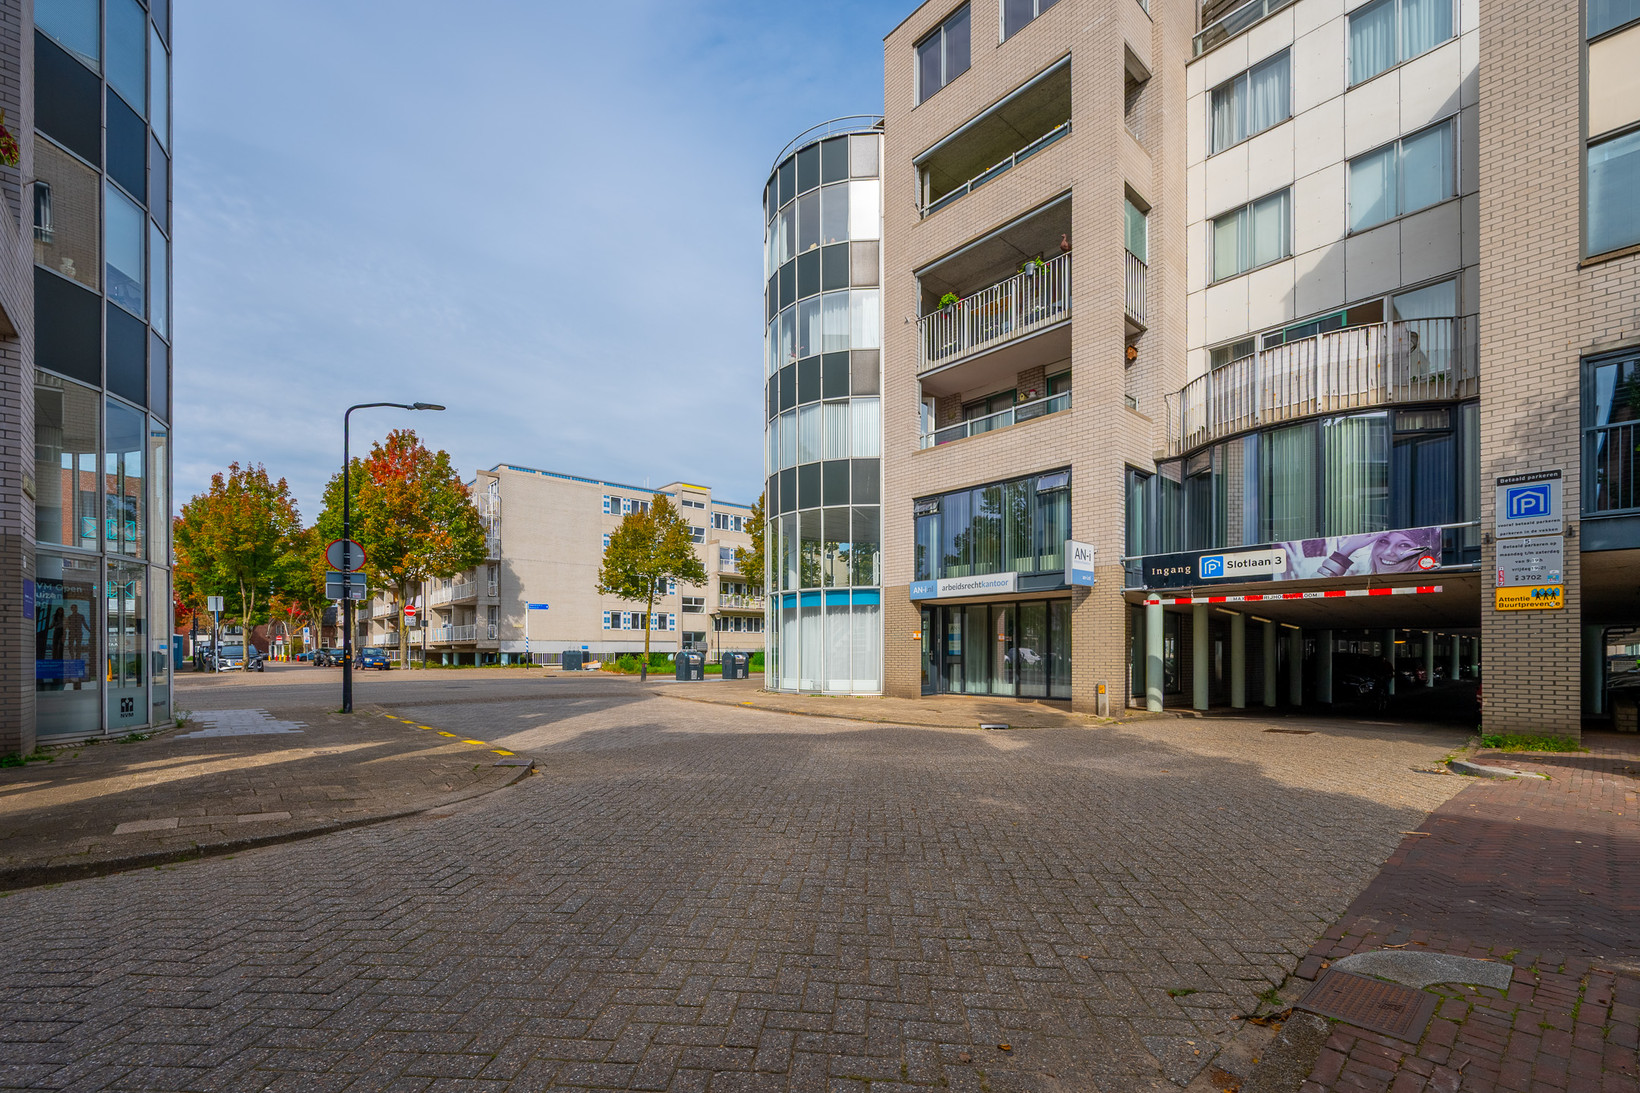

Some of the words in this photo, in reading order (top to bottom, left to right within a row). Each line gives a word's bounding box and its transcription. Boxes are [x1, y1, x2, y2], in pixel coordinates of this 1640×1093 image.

[1500, 476, 1526, 484] Betaald
[1527, 472, 1559, 480] parkeren
[1227, 558, 1271, 569] Slotlaan
[1274, 556, 1282, 565] 3
[1151, 565, 1192, 576] Ingang
[55, 583, 83, 593] Open
[941, 579, 1009, 591] arbeidsrechtkantoor
